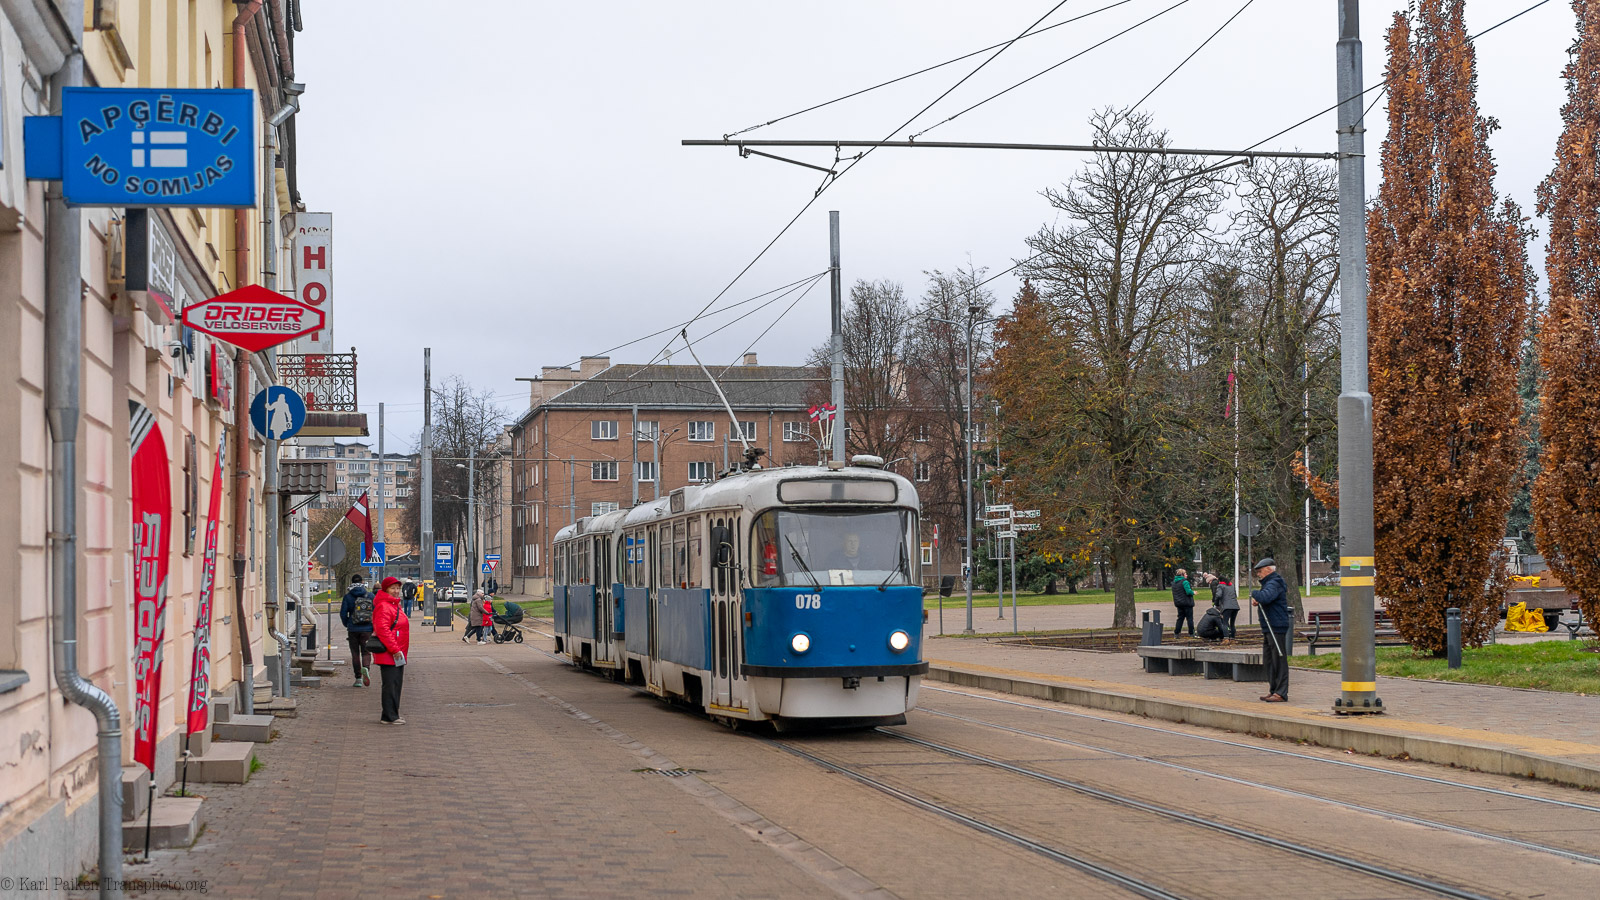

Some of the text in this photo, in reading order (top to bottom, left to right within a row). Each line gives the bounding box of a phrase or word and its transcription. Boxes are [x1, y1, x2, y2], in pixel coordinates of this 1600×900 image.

[79, 95, 239, 145] APĢĒRBI
[85, 154, 234, 196] NO SOMIJAS
[204, 305, 305, 323] DRIDER
[204, 321, 302, 331] VELOSERVISS
[302, 246, 327, 411] HOEL
[838, 572, 845, 585] 1
[795, 593, 821, 609] 078
